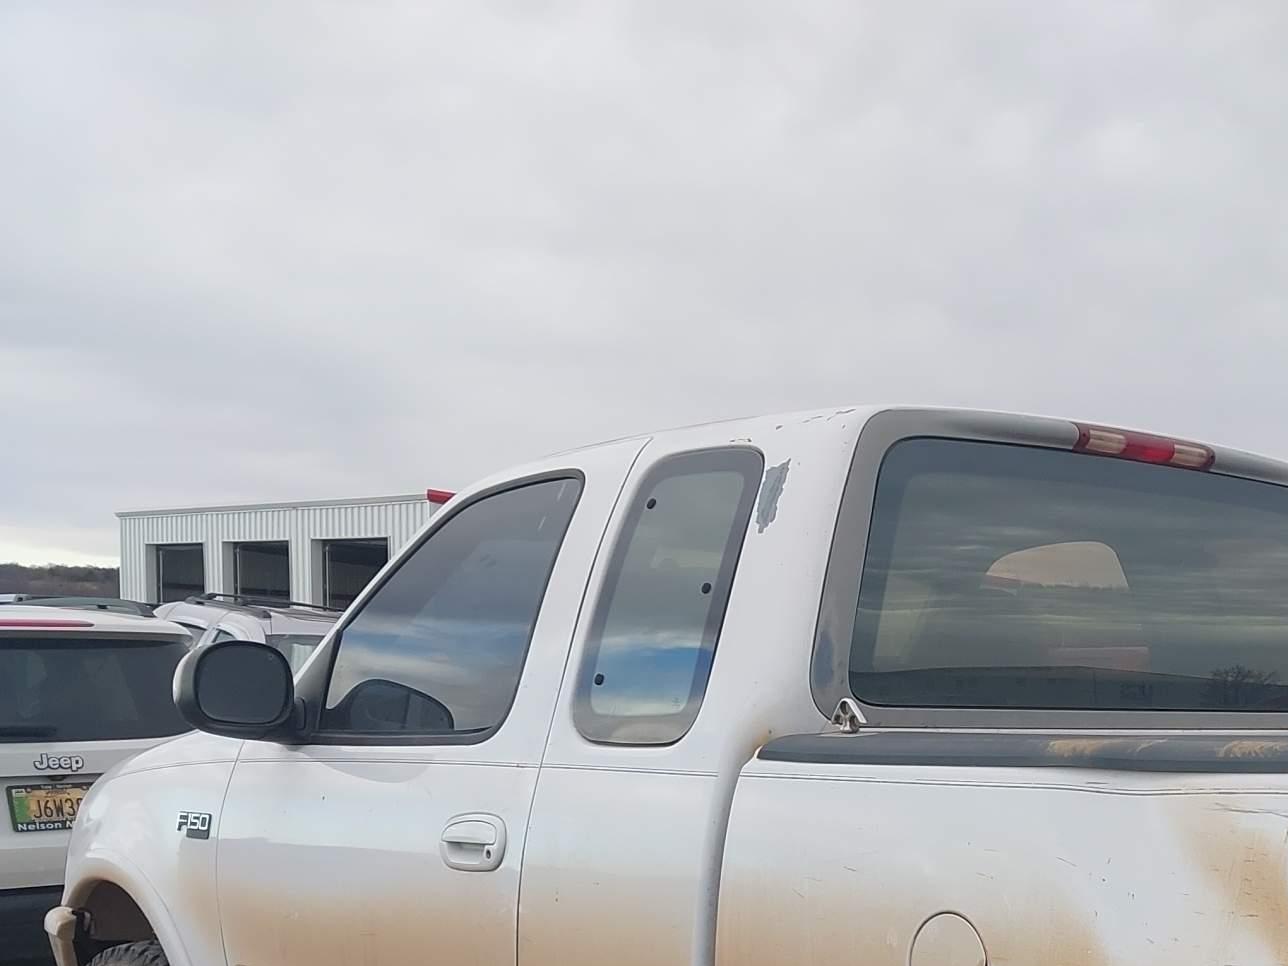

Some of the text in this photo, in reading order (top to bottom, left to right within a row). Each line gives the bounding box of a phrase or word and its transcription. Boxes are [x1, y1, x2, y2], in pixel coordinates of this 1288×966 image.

[33, 753, 84, 772] Jeep
[17, 821, 62, 832] Nelson
[175, 810, 212, 832] F150
